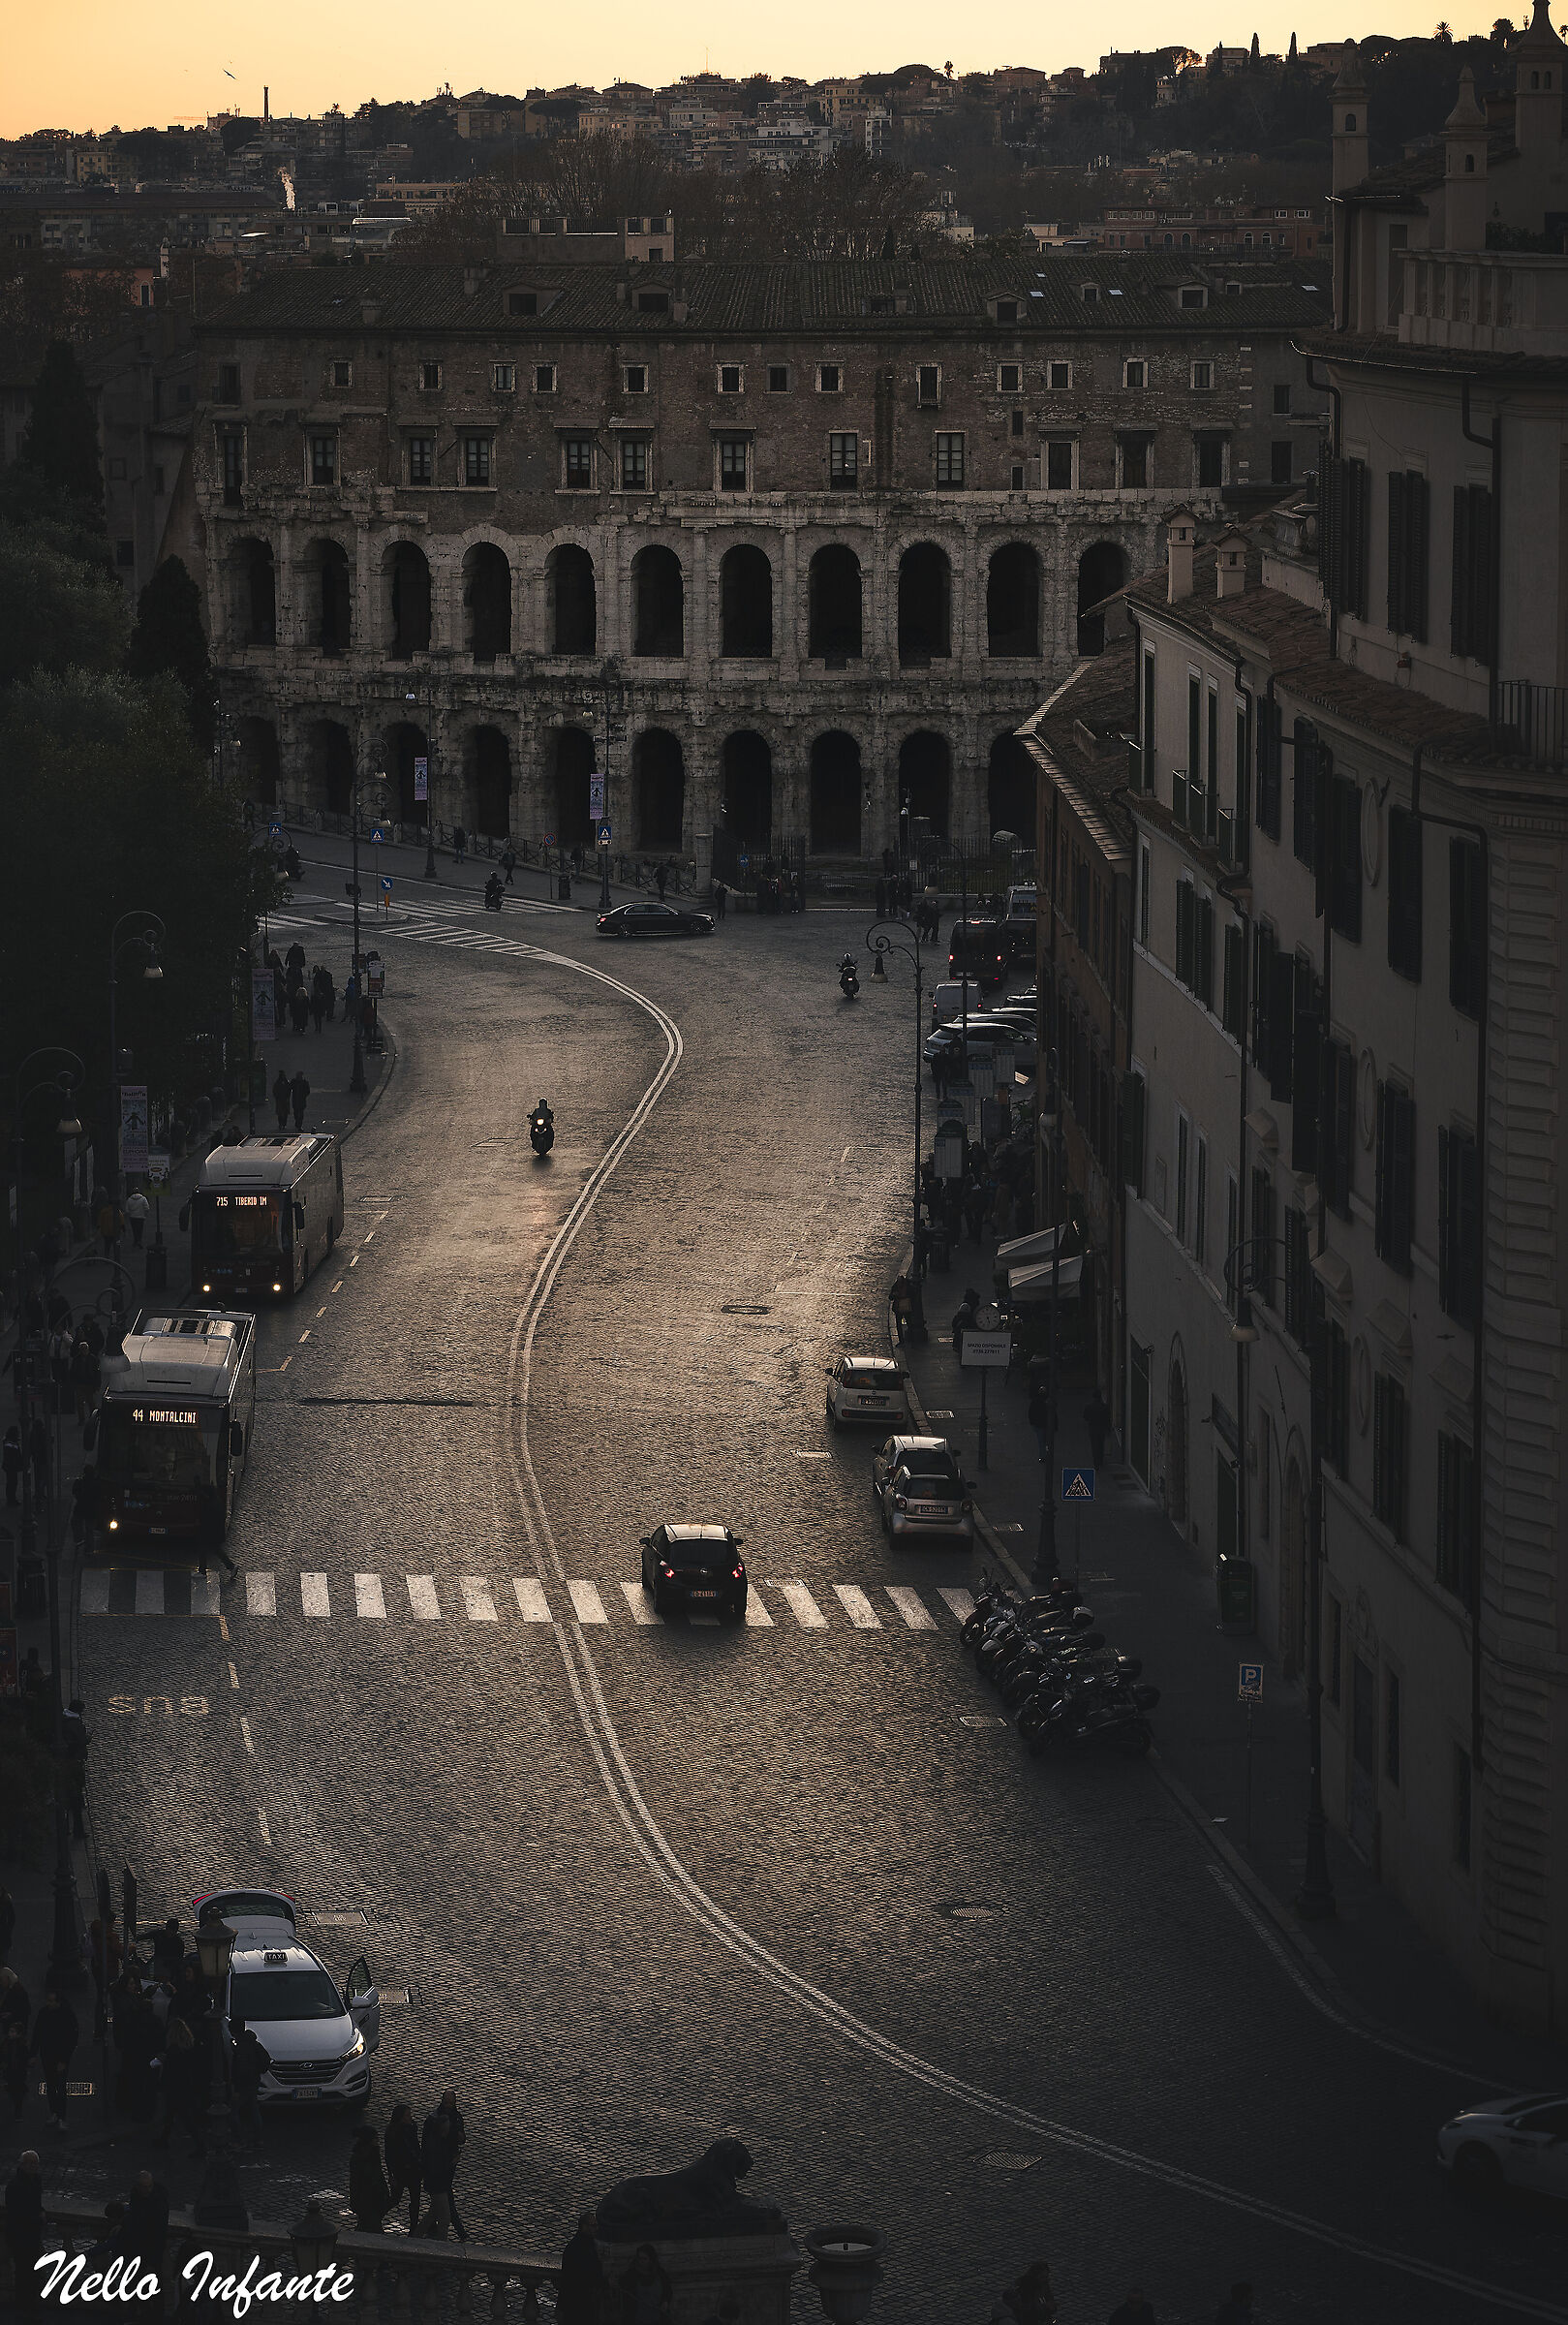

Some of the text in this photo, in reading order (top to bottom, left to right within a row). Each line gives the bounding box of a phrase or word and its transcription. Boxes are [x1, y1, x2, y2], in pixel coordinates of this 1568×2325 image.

[216, 1196, 229, 1206] 715
[235, 1196, 258, 1206] TIBERIO
[133, 1409, 197, 1424] 44 MONTALCINI
